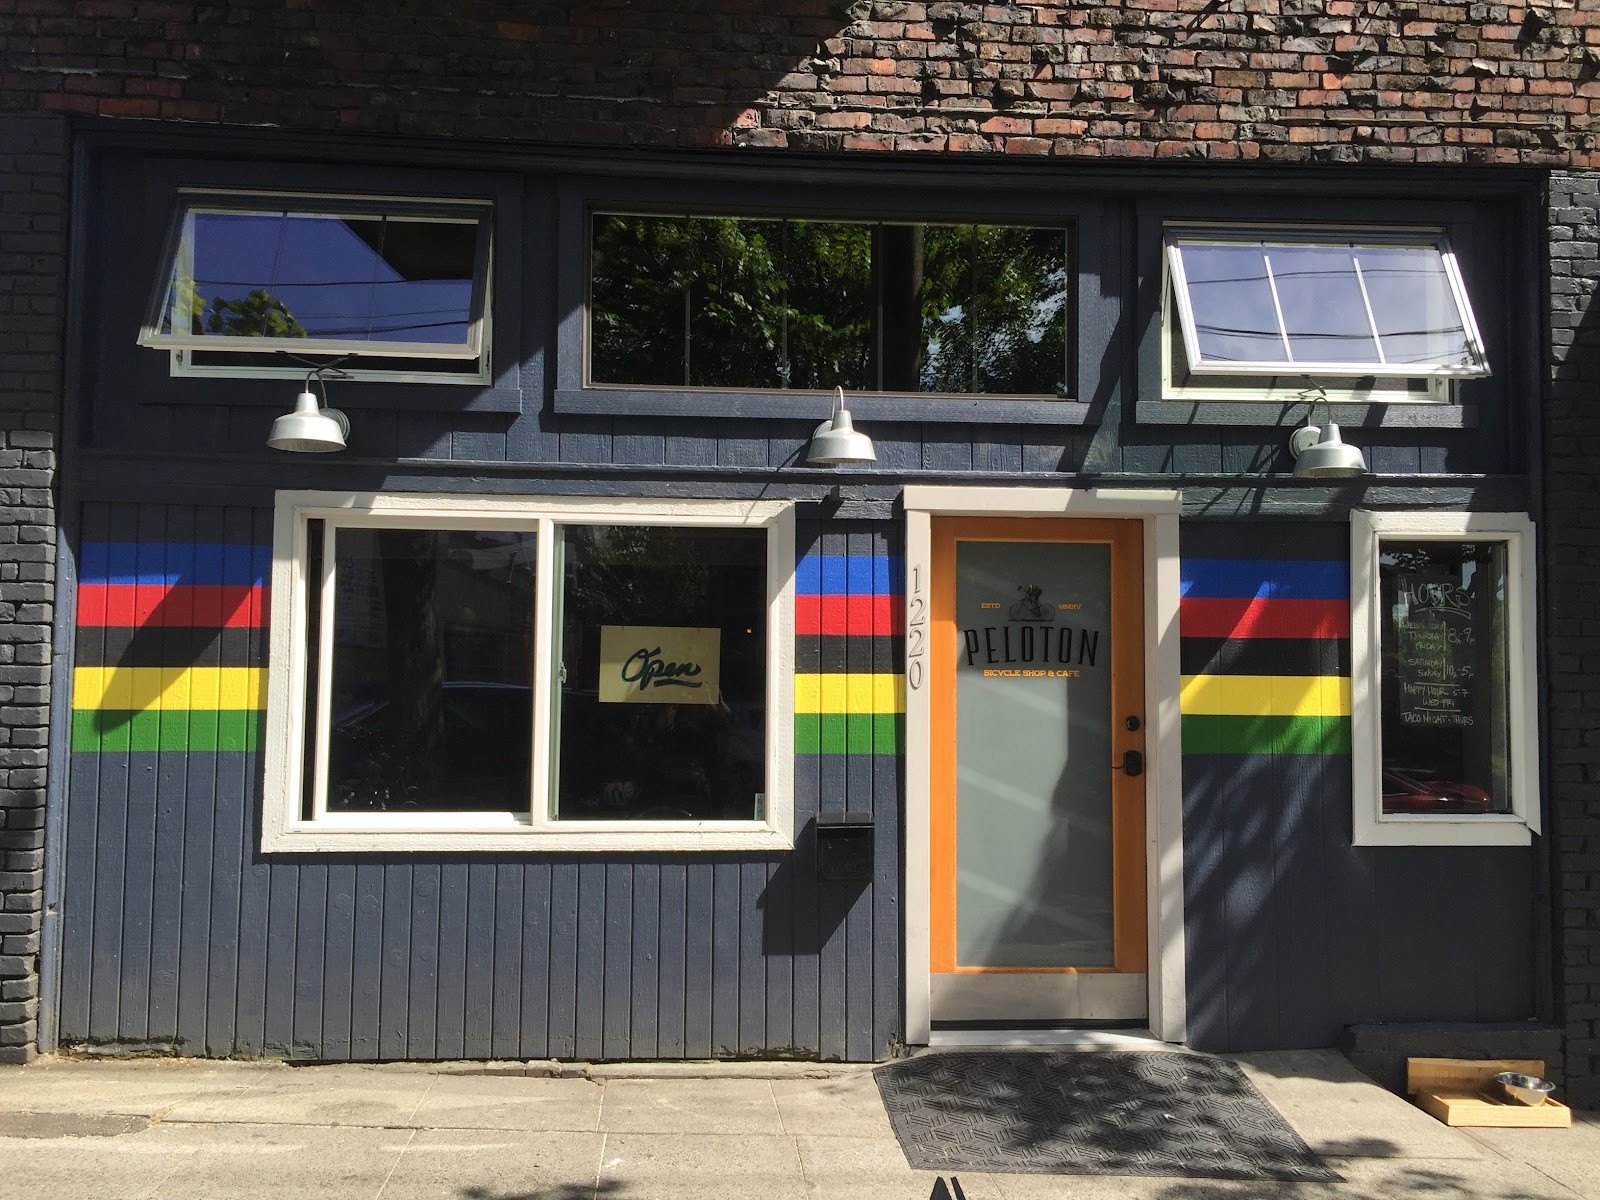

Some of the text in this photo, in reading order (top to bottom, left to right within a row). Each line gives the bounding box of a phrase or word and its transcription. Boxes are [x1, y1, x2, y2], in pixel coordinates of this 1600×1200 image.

[1400, 578, 1471, 608] HOURS
[908, 563, 926, 691] 1220
[963, 626, 1099, 667] PELOTON
[621, 646, 702, 691] Open
[1408, 658, 1443, 668] SATURDAY
[983, 669, 1080, 677] BICYCLE SHOP & CAFE
[1417, 668, 1442, 678] SUNDAY
[1403, 682, 1426, 695] HAPPY
[1427, 686, 1449, 697] HOUR
[1402, 711, 1421, 723] TACO
[1422, 711, 1447, 724] NIGHT
